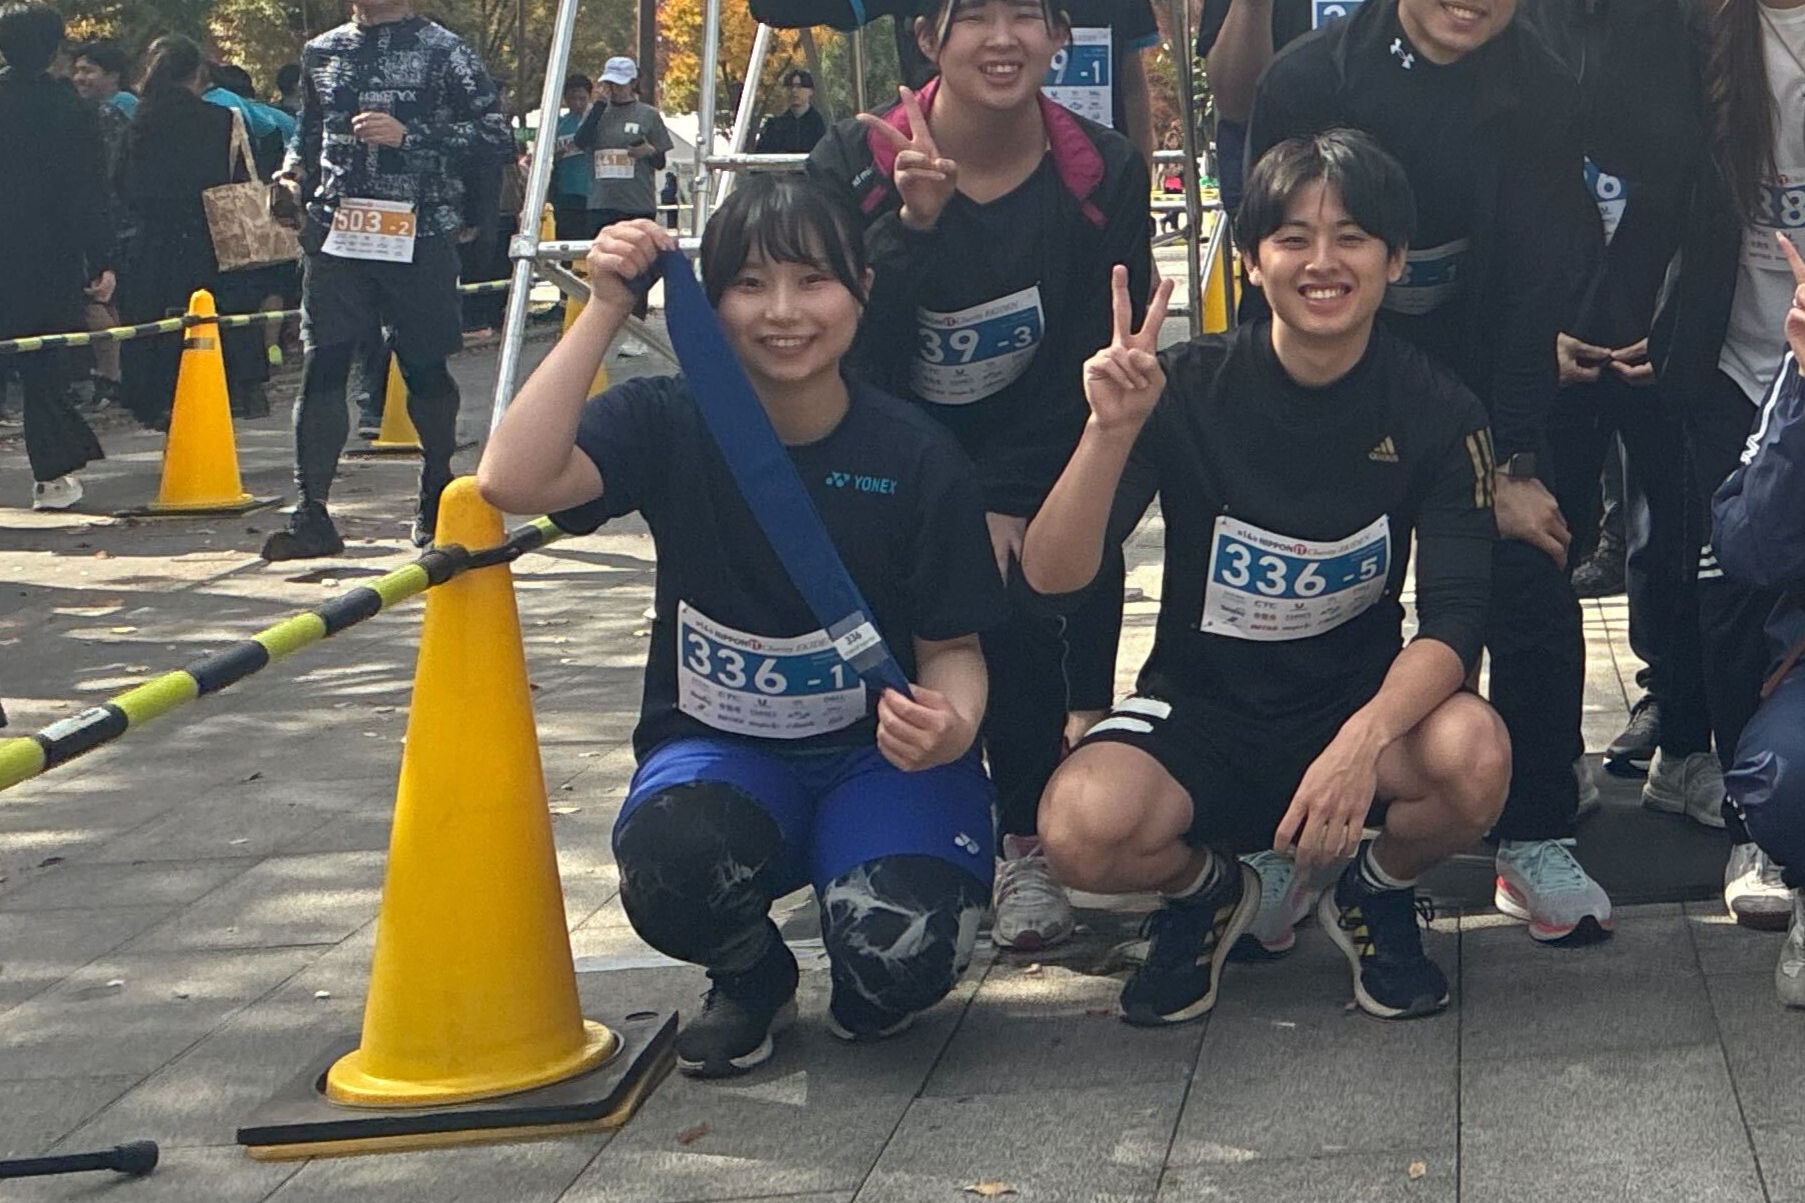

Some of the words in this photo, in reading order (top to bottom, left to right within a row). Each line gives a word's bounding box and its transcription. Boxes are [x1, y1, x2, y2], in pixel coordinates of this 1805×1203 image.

[1080, 60, 1100, 84] -1
[337, 209, 382, 232] 503
[389, 221, 410, 235] -2
[997, 326, 1032, 347] -3
[854, 474, 897, 495] YONEX
[1221, 543, 1326, 596] 336
[1342, 556, 1378, 582] -5
[688, 633, 788, 694] 336
[808, 664, 843, 689] -1
